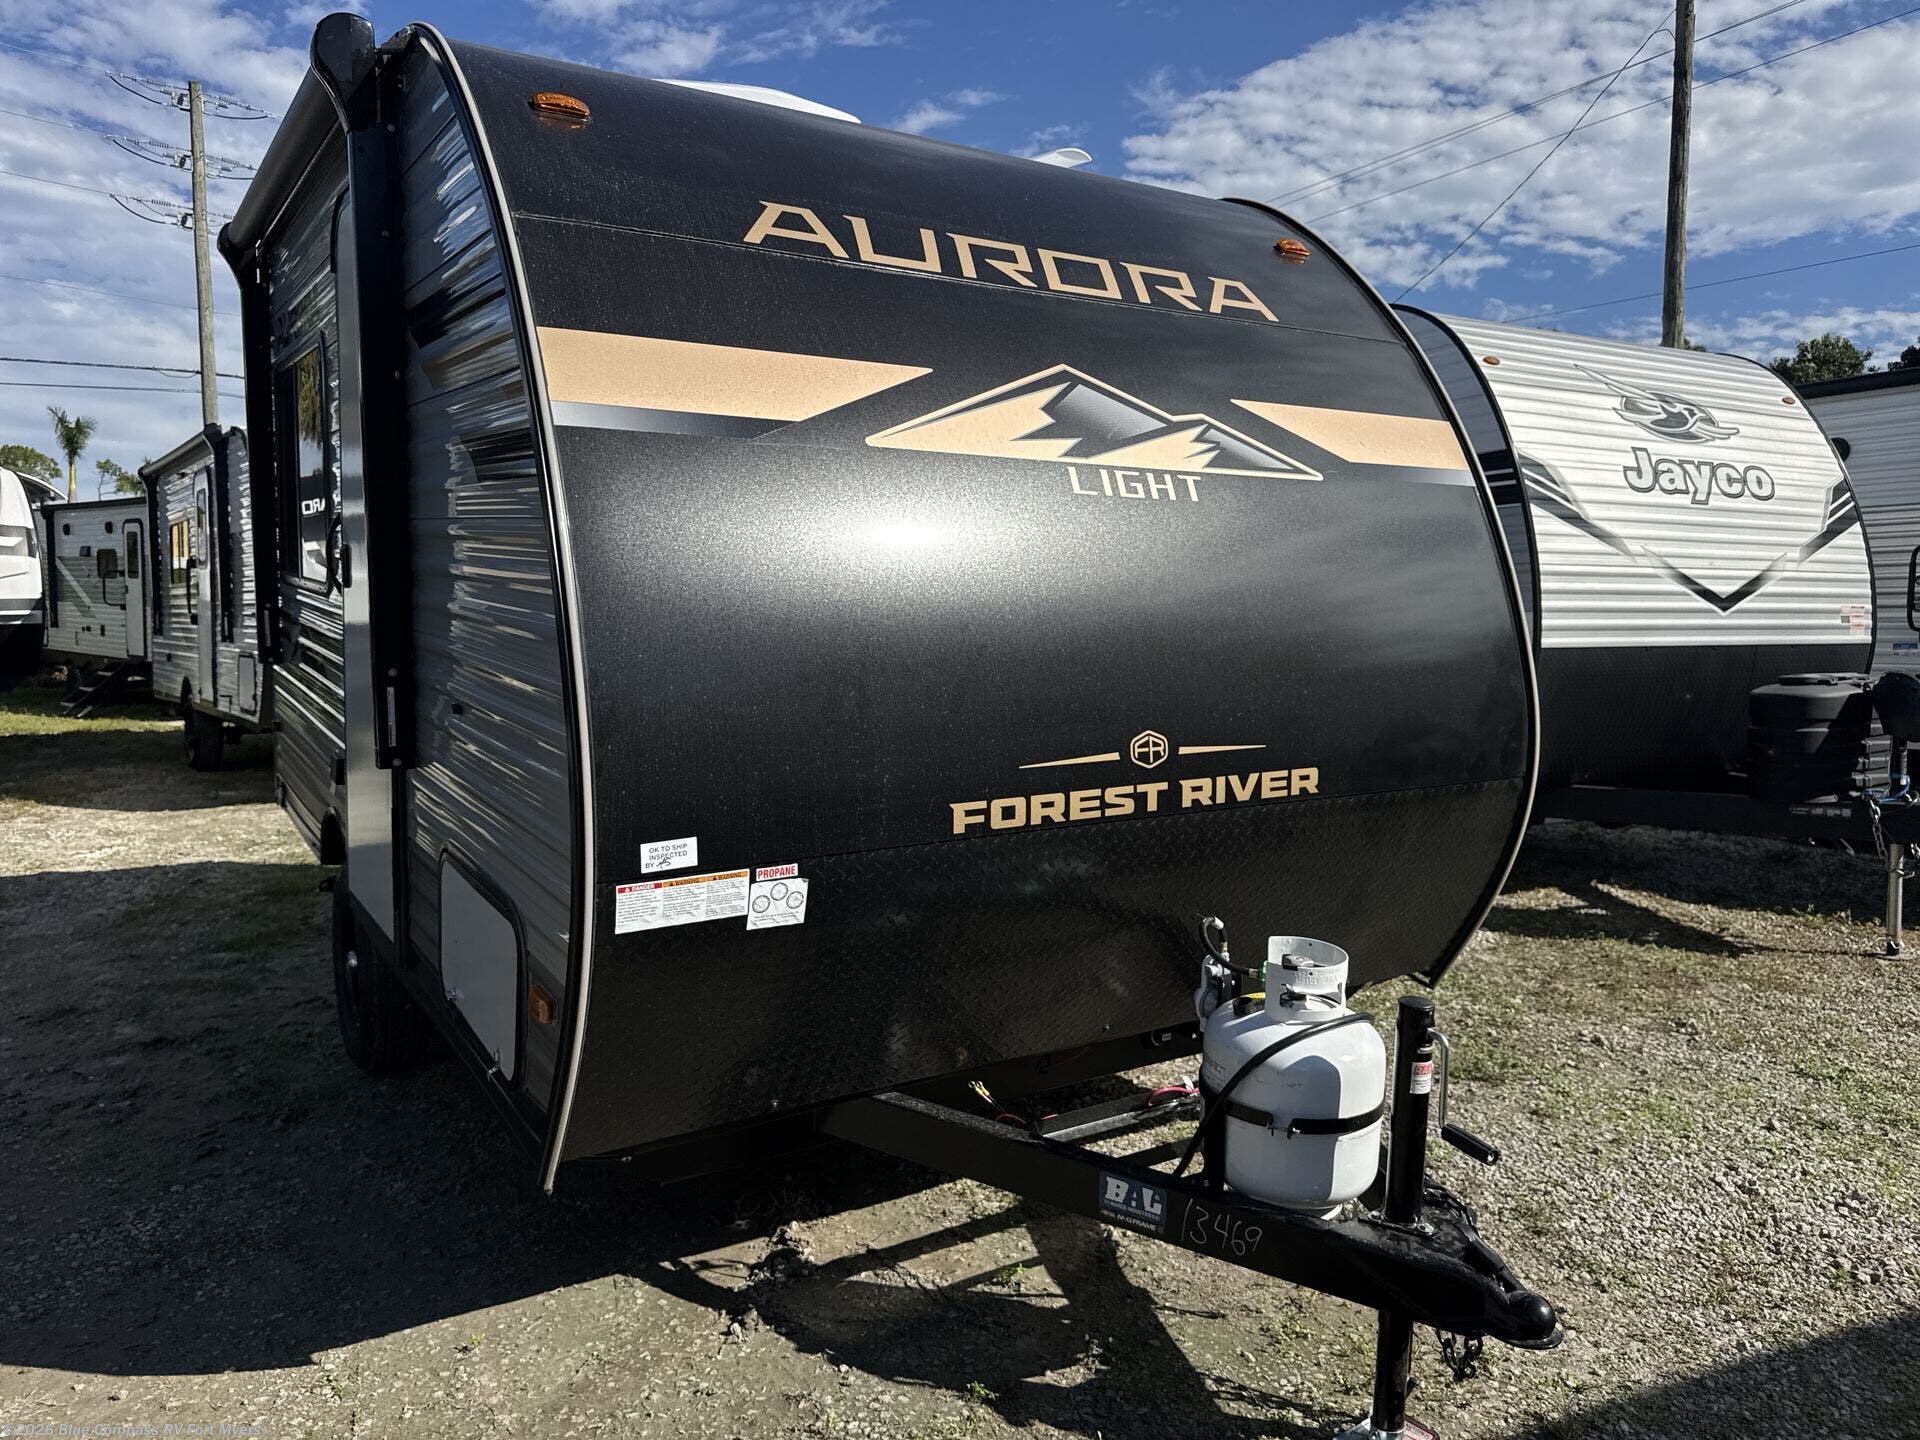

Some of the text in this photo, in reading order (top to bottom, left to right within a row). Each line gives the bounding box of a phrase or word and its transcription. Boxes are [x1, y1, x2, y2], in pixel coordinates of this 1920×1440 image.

[743, 200, 1279, 322] AURORA
[1067, 466, 1201, 502] LIGHT
[1623, 446, 1775, 505] Jayco
[949, 767, 1319, 834] FOREST RIVER
[648, 850, 688, 861] INSPECTED
[671, 842, 688, 851] SHIP
[631, 883, 656, 892] DANGER
[757, 865, 797, 879] PROPANE
[1104, 1176, 1163, 1215] BAL
[1181, 1197, 1263, 1256] 13469
